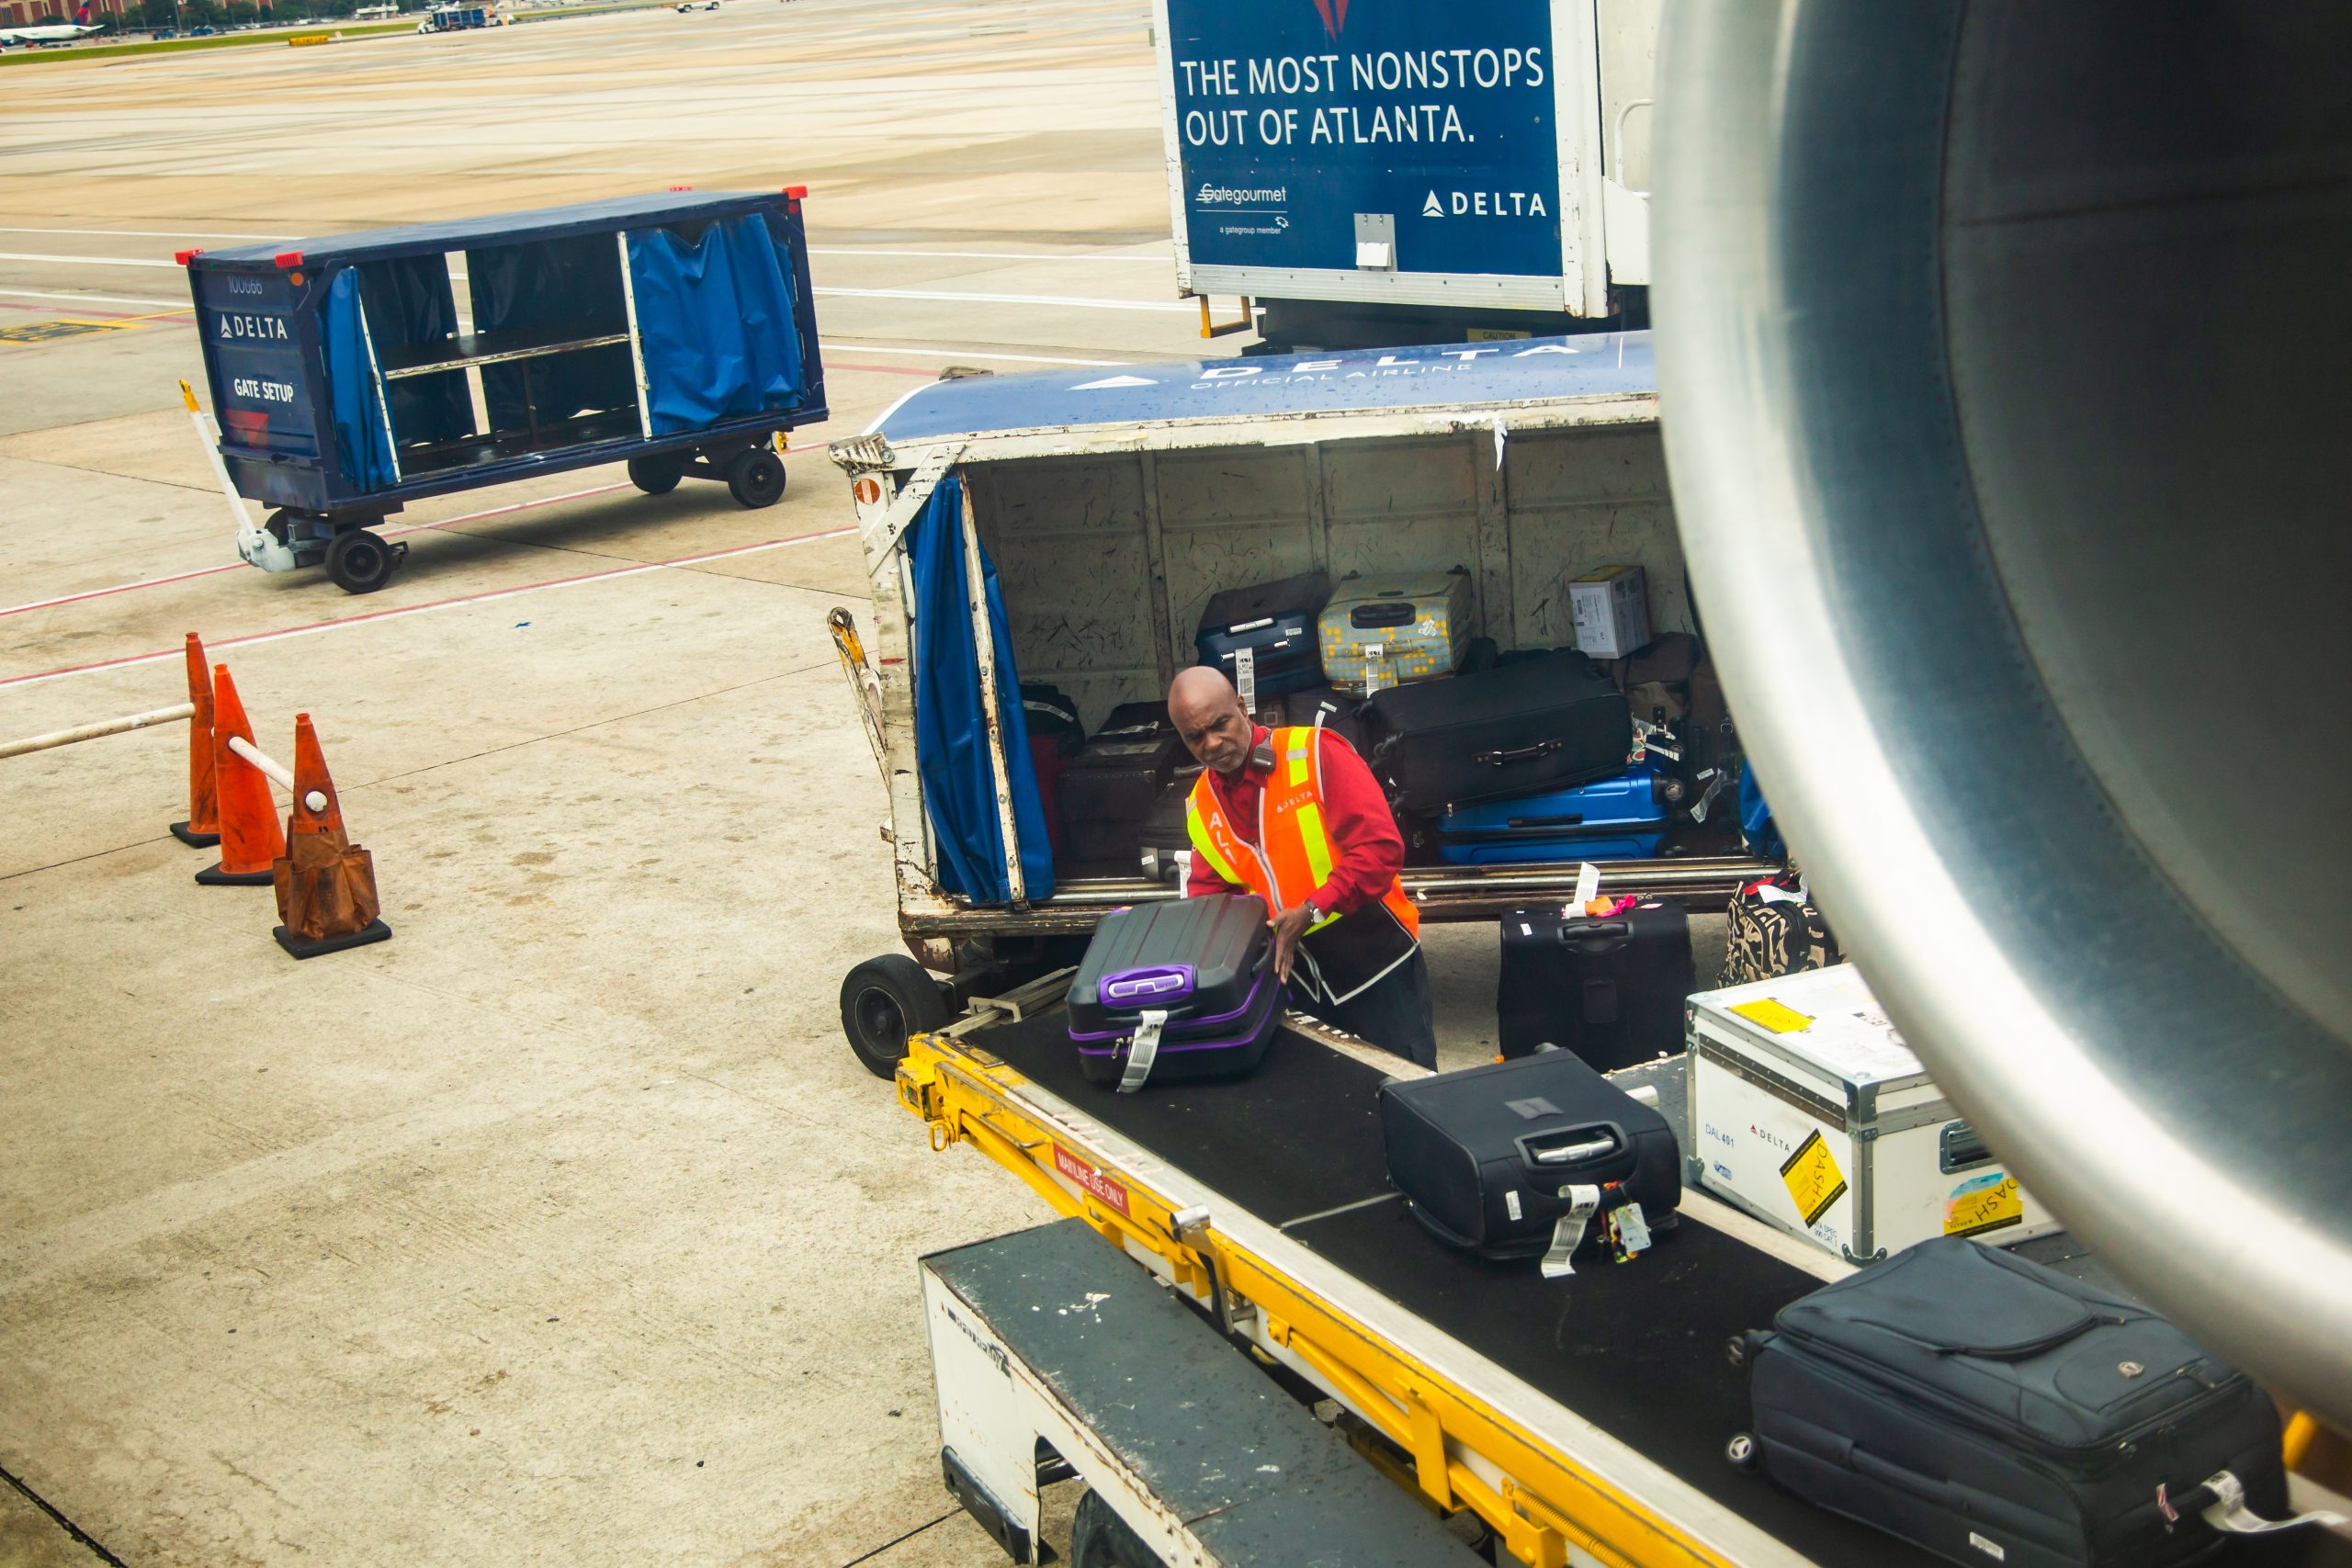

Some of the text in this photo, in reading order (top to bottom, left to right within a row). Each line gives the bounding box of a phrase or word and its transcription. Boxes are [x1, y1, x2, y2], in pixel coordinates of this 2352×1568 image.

[1180, 47, 1544, 96] THE MOST NONSTOPS
[1185, 105, 1475, 146] OUT OF ATLANTA.
[1195, 183, 1286, 205] Gategourmet
[1452, 191, 1547, 217] DELTA
[1225, 226, 1255, 235] gategroup
[1256, 226, 1282, 234] member
[233, 315, 288, 340] DELTA
[1483, 331, 1516, 340] CAUTION
[1200, 345, 1580, 379] DELTA
[1190, 364, 1473, 389] OFFICIAL AIRLINE
[234, 378, 294, 403] GATE SETUP
[1759, 1129, 1791, 1153] DELTA
[1812, 1143, 1828, 1198] DASH
[1089, 1172, 1105, 1196] USE
[1104, 1182, 1125, 1208] ONLY
